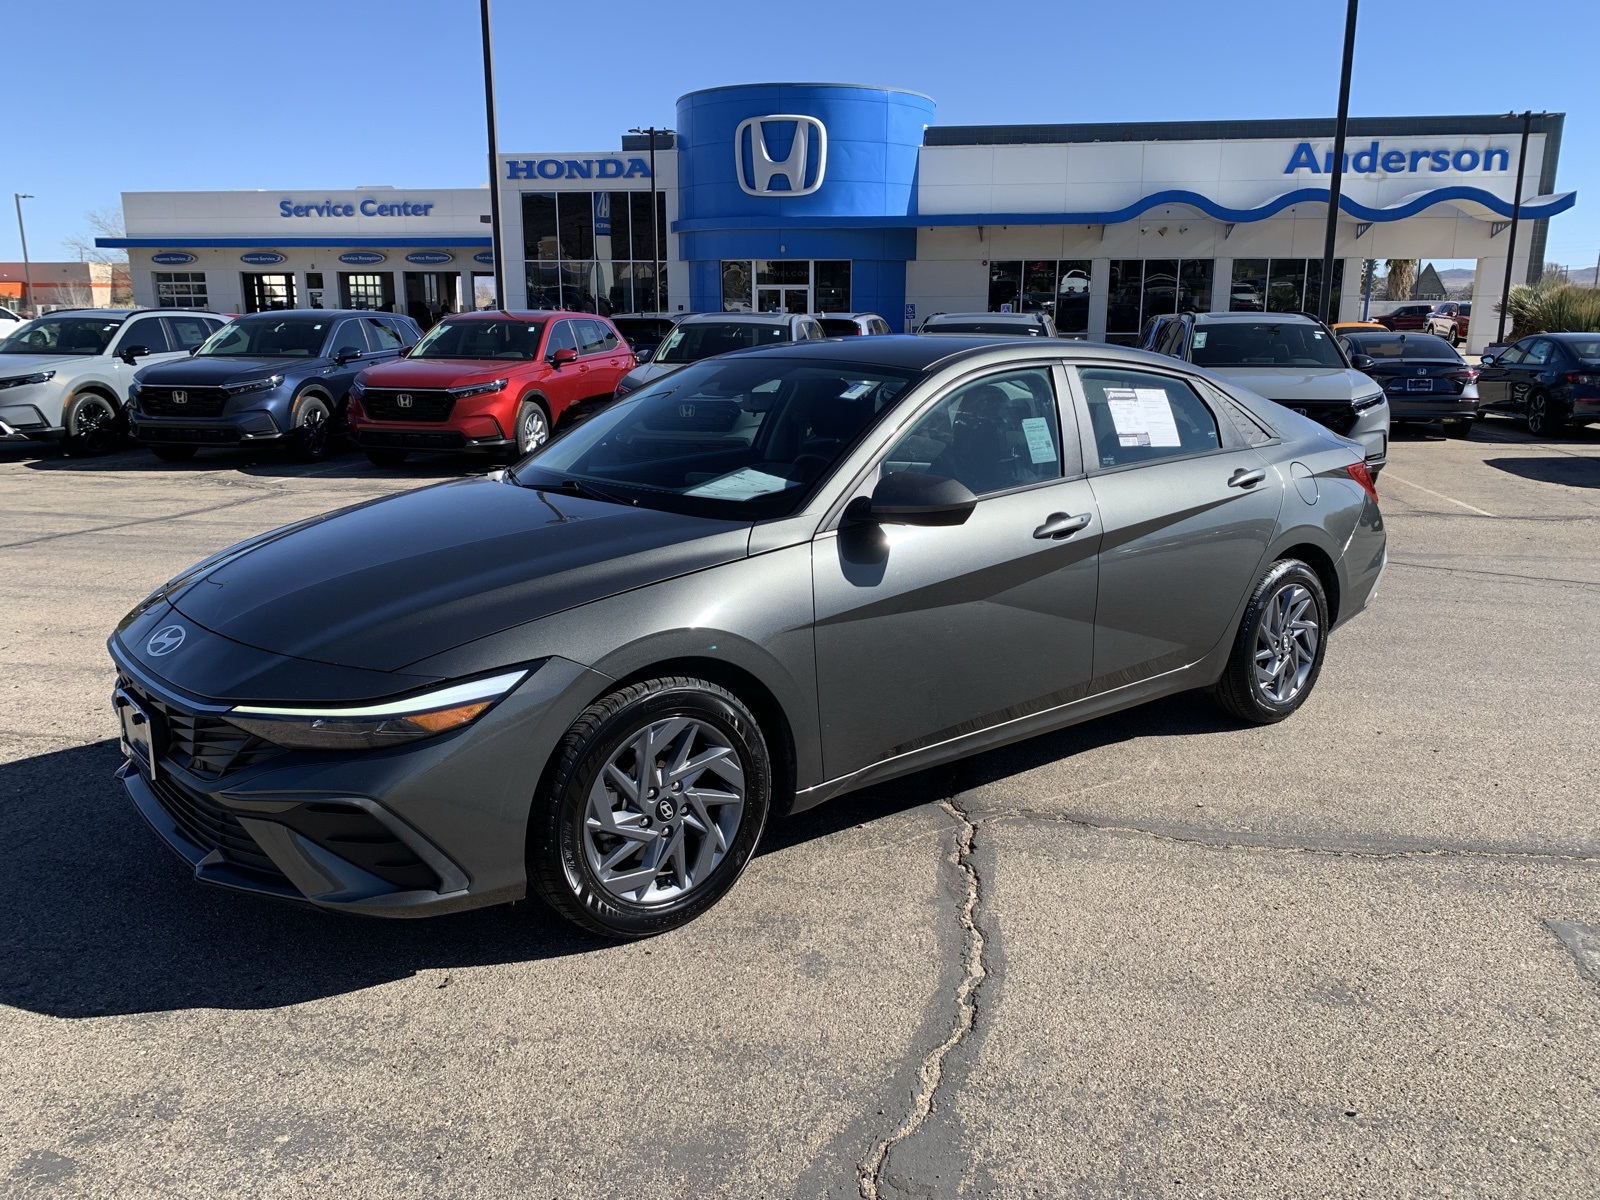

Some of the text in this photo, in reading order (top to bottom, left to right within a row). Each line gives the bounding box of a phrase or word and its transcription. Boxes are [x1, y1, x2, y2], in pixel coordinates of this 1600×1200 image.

[505, 157, 652, 180] HONDA
[1283, 141, 1510, 175] Anderson
[279, 198, 434, 218] Service Center
[358, 255, 382, 263] Reception
